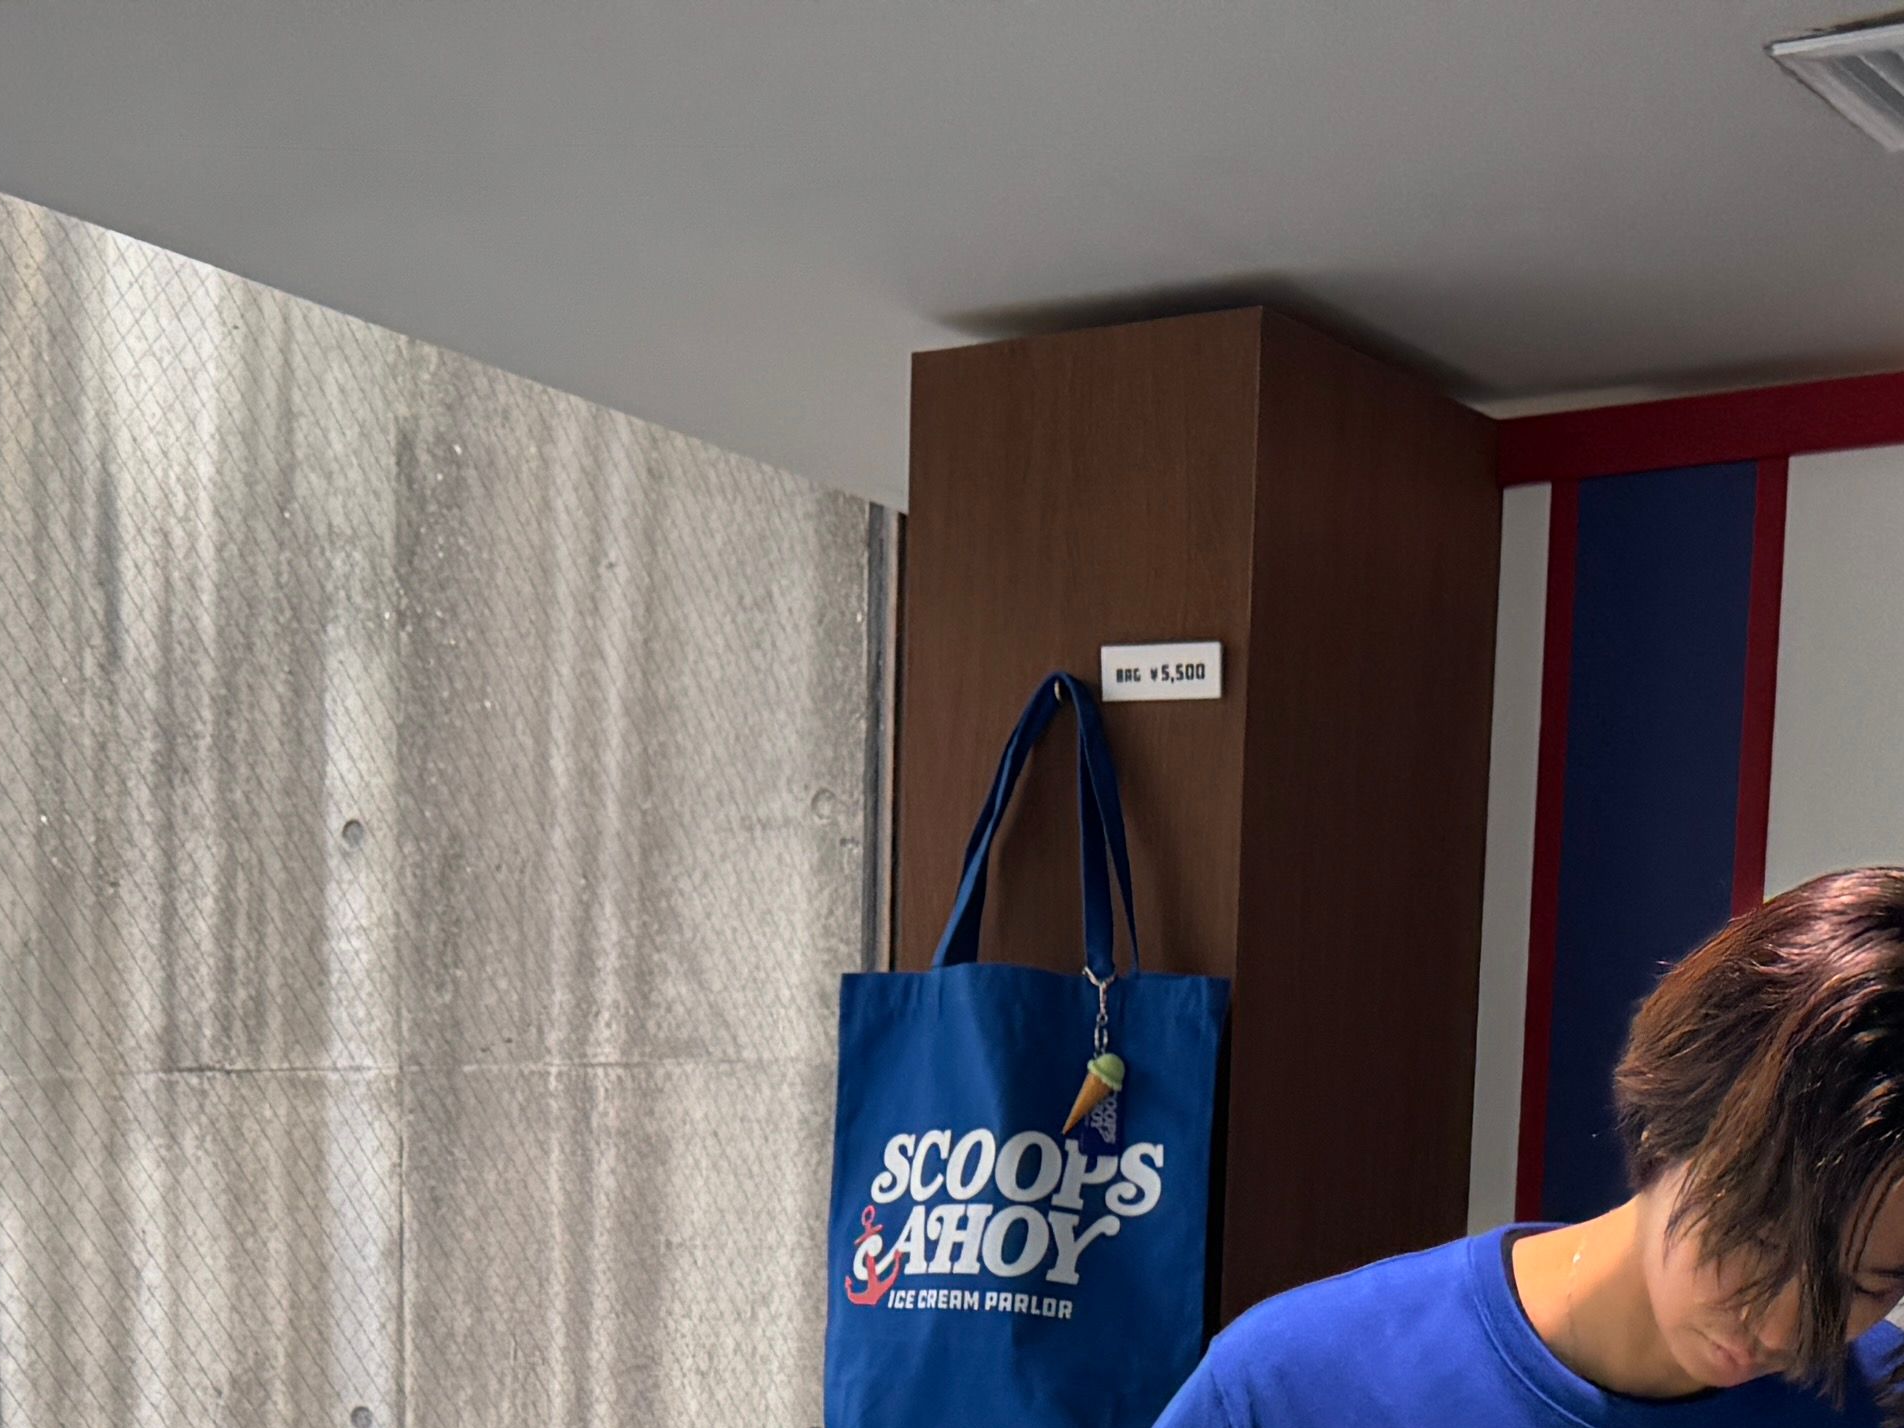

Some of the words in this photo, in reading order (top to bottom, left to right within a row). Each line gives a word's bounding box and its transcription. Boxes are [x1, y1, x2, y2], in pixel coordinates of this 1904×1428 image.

[1149, 662, 1206, 684] ¥5,500
[870, 1127, 1165, 1217] SCOOPS
[852, 1203, 1121, 1286] AHOY
[887, 1288, 915, 1309] ICE
[917, 1289, 980, 1311] CREAM
[984, 1291, 1073, 1320] PARLOR
